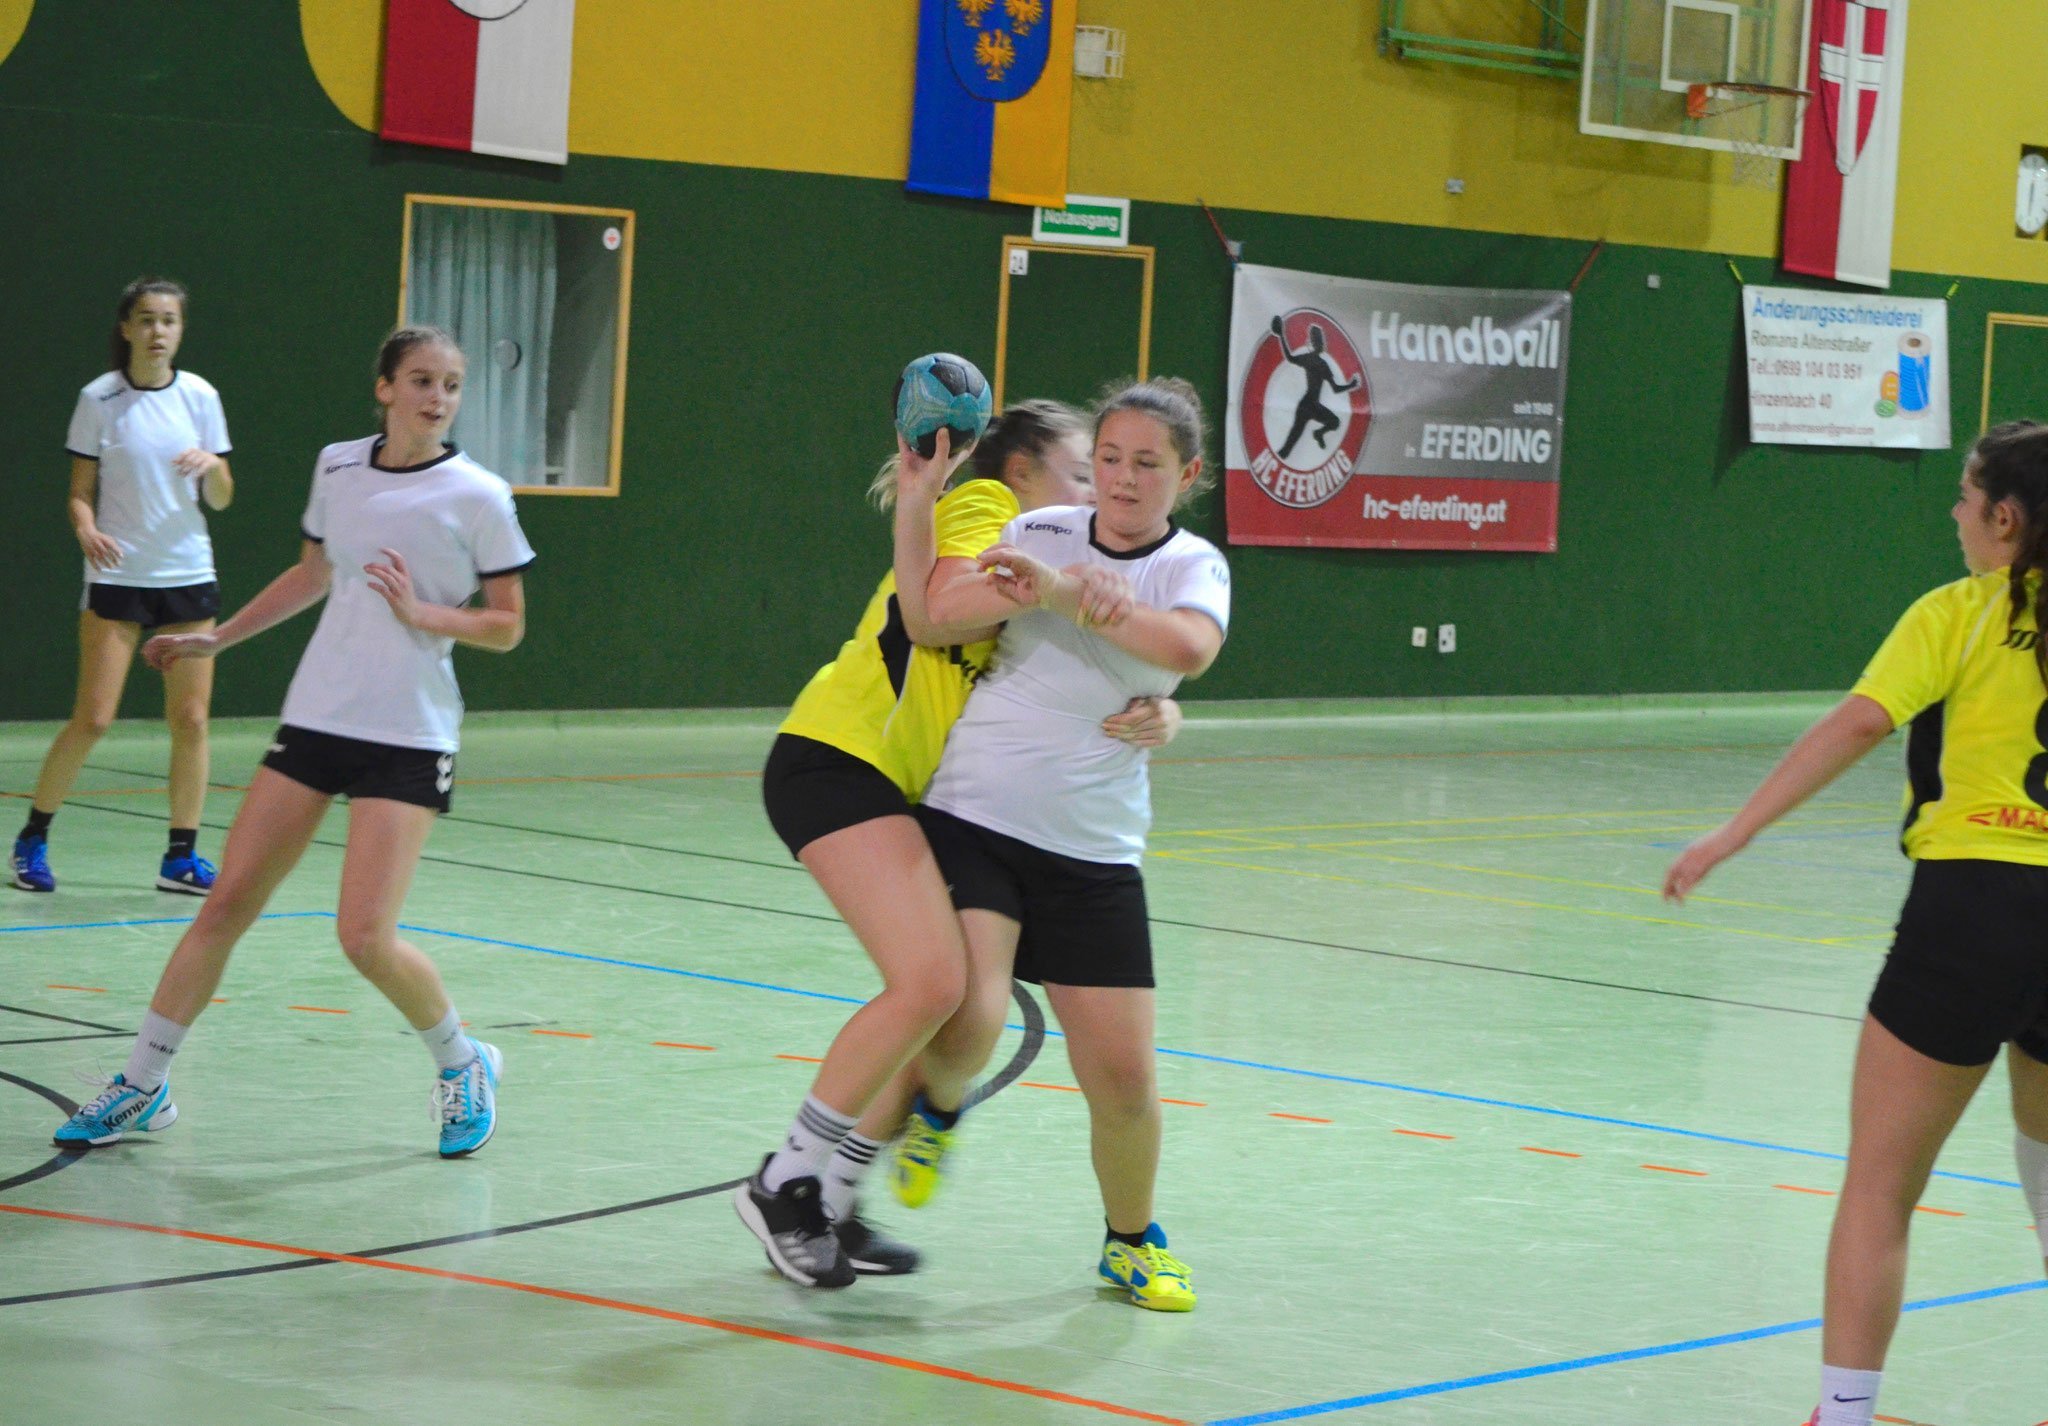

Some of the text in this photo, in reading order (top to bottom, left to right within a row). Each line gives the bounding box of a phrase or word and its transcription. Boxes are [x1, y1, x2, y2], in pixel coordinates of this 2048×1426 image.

[1043, 208, 1119, 232] Notausgang
[1752, 291, 1923, 328] Änderungsschneiderei
[1370, 310, 1560, 369] Handball
[1751, 330, 1872, 352] Romana Altenstraßer
[1805, 361, 1824, 377] 104
[1827, 362, 1840, 379] 03
[1819, 393, 1832, 409] 40
[1420, 423, 1551, 464] EFERDING
[1252, 448, 1353, 503] HC EFERDING
[1363, 493, 1507, 530] hc-eferding.at
